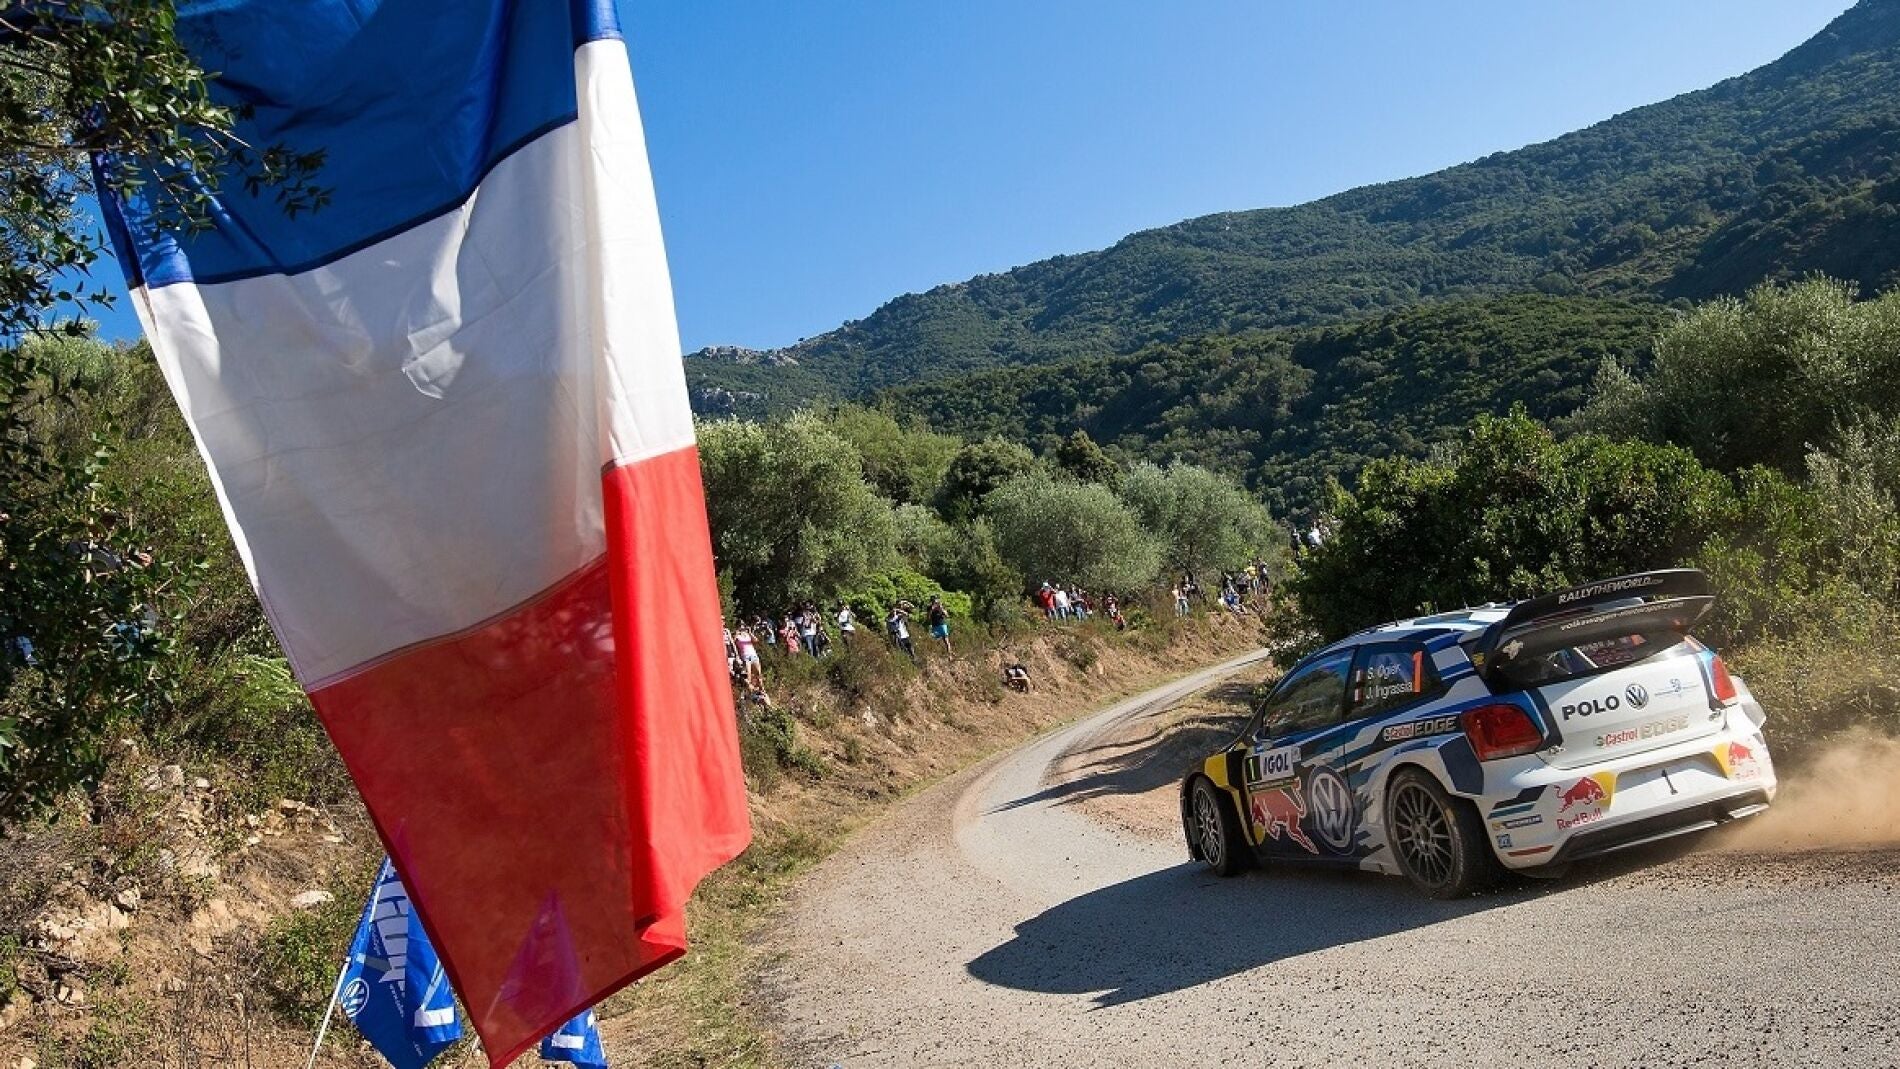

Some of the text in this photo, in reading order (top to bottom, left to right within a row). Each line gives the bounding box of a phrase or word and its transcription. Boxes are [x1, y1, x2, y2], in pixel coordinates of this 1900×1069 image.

[1412, 651, 1423, 693] 1
[1375, 681, 1412, 699] Ingrassia
[1562, 695, 1620, 721] POLO
[1415, 716, 1457, 736] EDGE
[1605, 713, 1689, 746] Castrol EDGE
[1263, 752, 1289, 776] IGOL
[1661, 769, 1679, 796] 1
[1557, 808, 1603, 830] Red Bull
